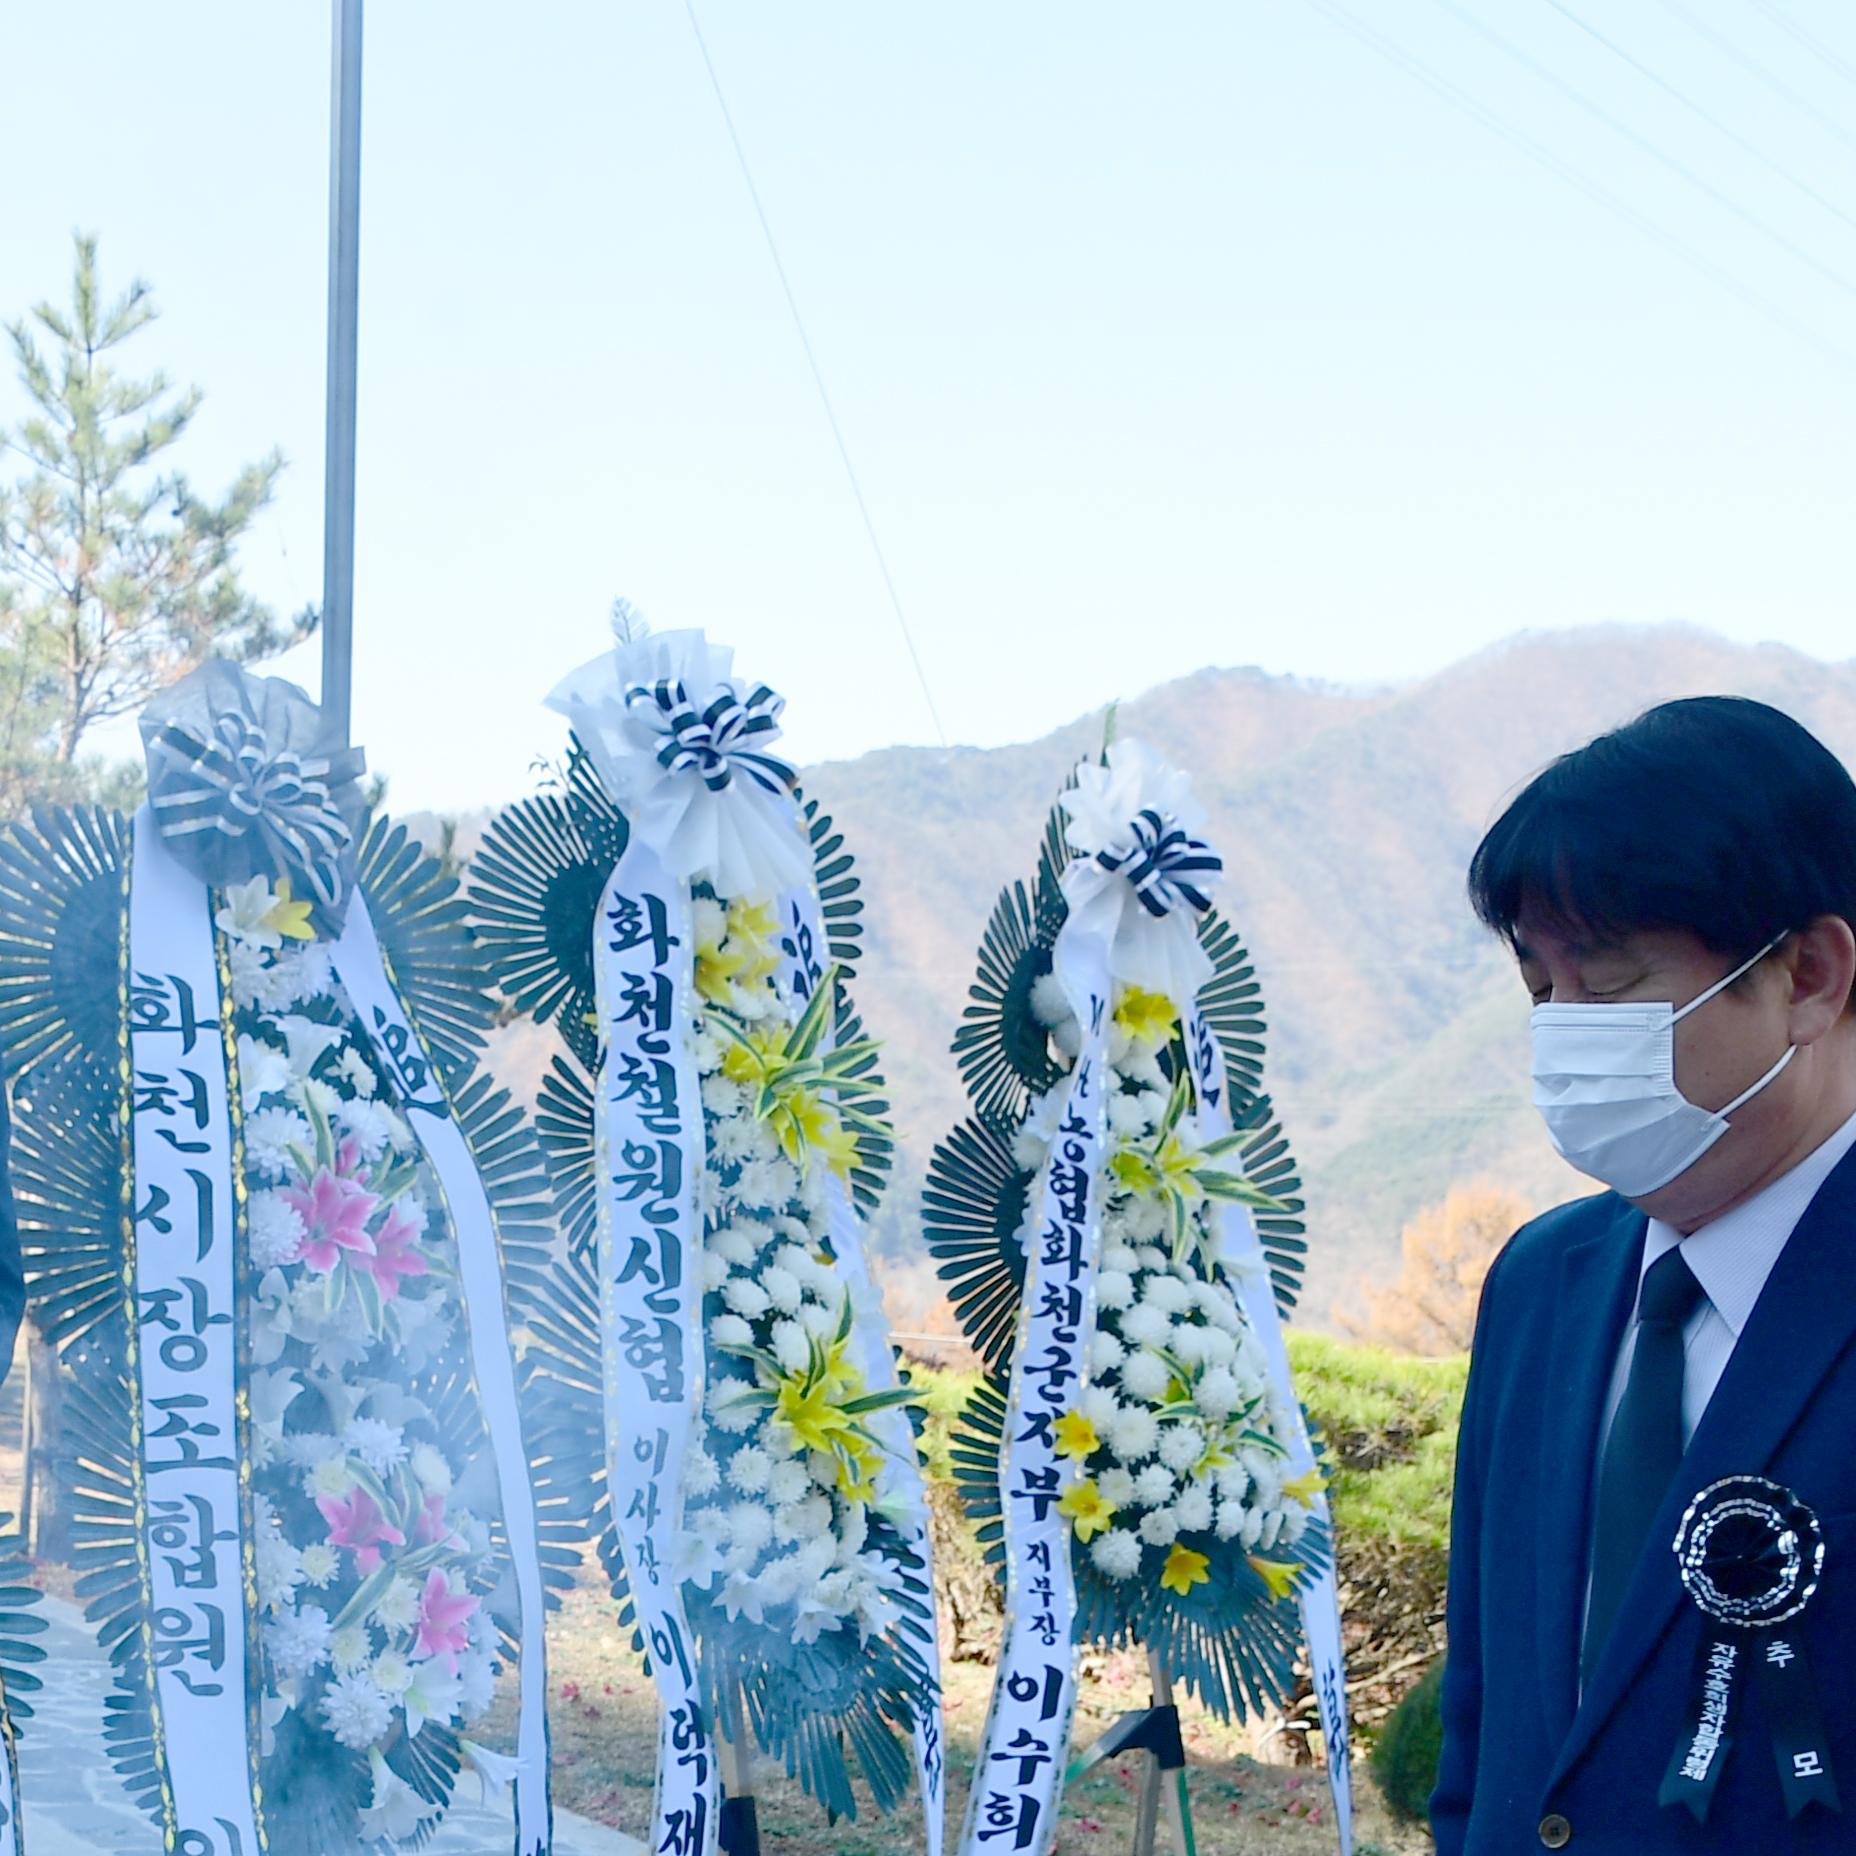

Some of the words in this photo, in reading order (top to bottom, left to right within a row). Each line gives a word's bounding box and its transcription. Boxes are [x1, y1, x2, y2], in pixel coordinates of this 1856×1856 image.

[607, 891, 683, 1403] 화천철원신협
[130, 972, 239, 1696] 화천시장조합원
[625, 1427, 670, 1587] 이사장
[1026, 1540, 1061, 1646] 지부장
[977, 1663, 1064, 1851] 이수희
